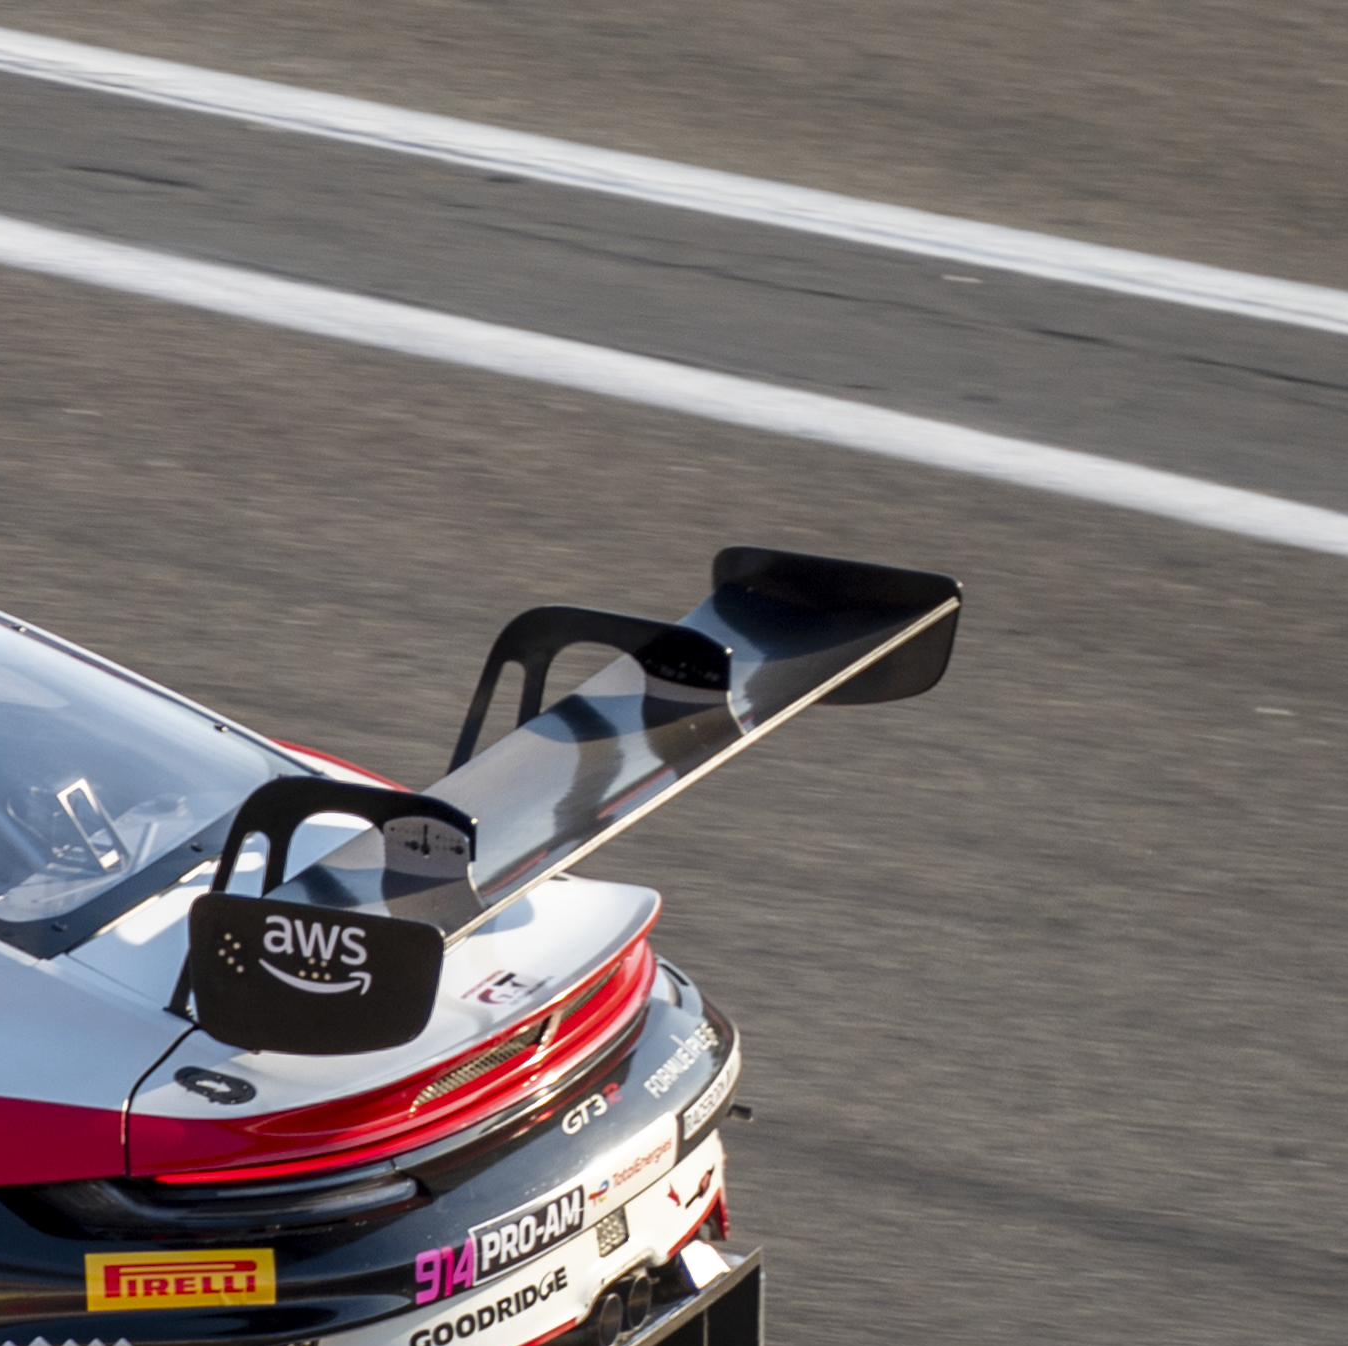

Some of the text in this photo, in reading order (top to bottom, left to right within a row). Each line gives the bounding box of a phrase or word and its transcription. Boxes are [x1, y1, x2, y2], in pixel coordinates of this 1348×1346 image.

[263, 914, 368, 968] aws
[415, 1188, 582, 1306] 914 PRO-AM
[103, 1259, 258, 1299] PIRELLI
